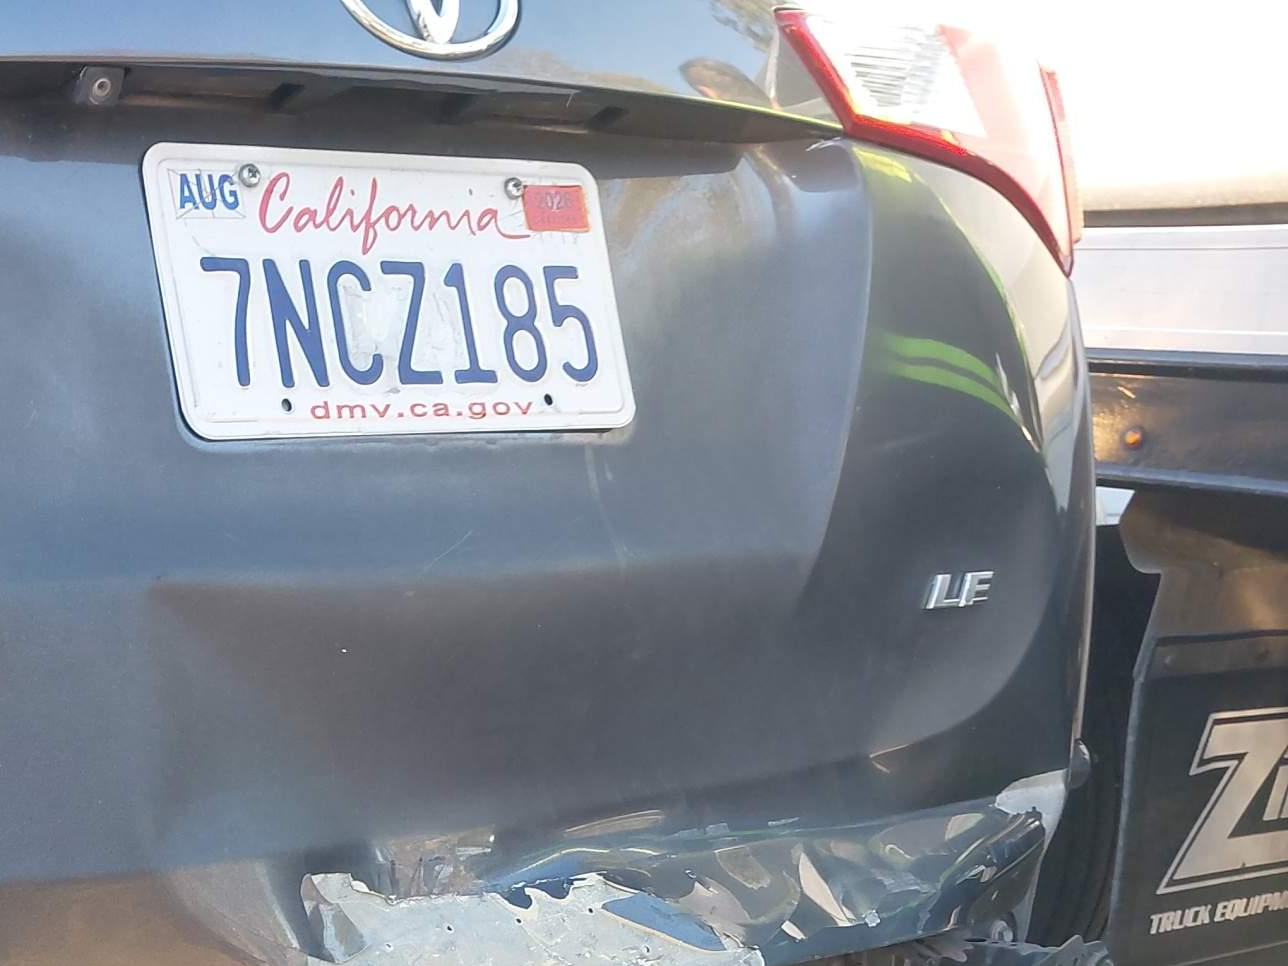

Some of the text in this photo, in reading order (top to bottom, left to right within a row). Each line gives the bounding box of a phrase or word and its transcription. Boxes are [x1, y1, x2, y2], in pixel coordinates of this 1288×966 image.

[178, 173, 240, 211] AUG
[259, 172, 530, 256] California
[200, 256, 599, 389] 7NCZ185
[310, 400, 533, 420] dmv.ca.gov
[925, 571, 994, 609] LE
[1150, 905, 1212, 935] TRUCK
